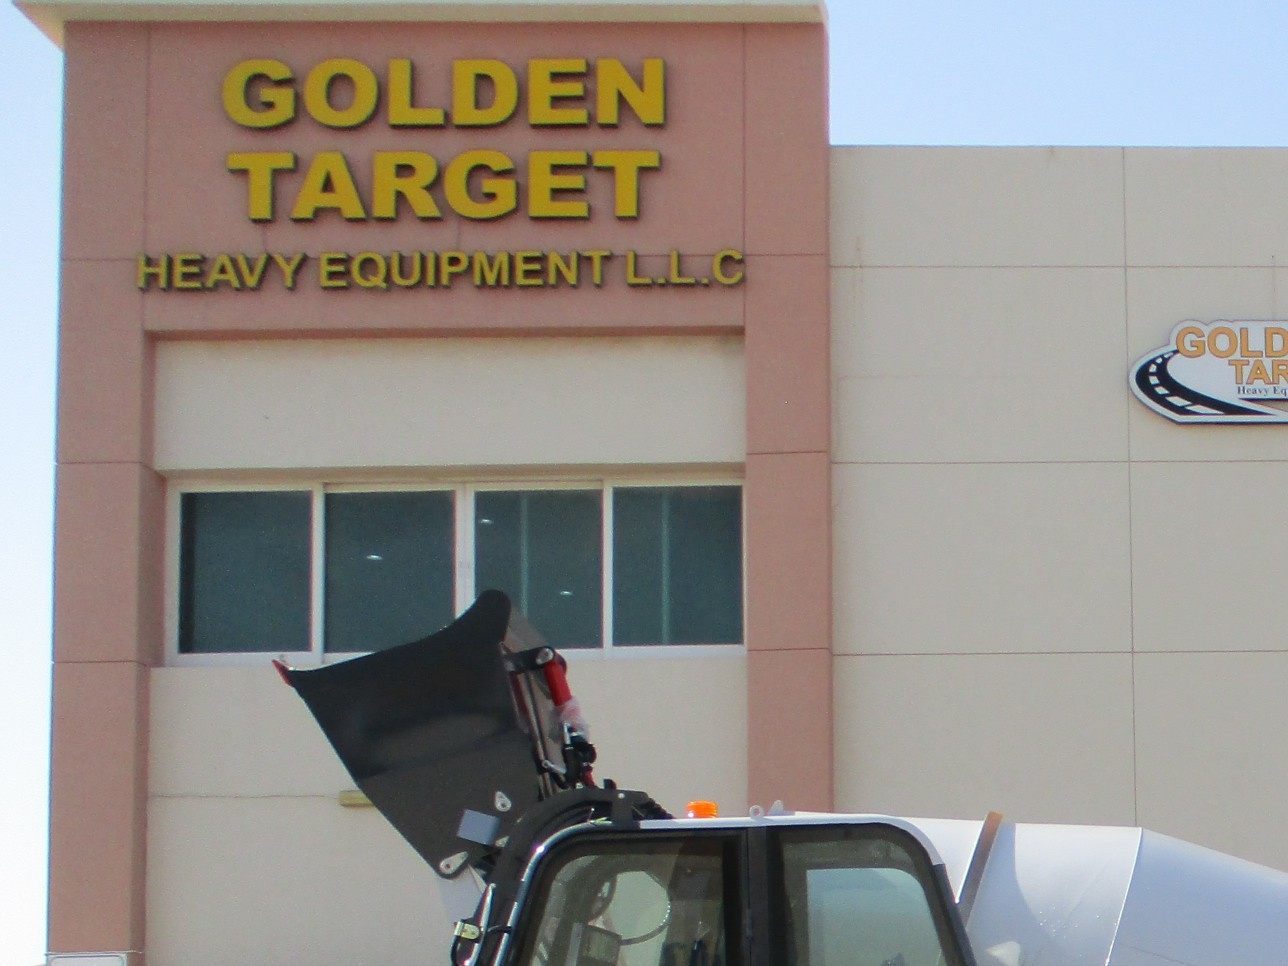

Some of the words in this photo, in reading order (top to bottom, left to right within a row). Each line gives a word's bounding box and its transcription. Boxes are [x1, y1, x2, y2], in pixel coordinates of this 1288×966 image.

[221, 57, 668, 128] GOLDEN
[226, 149, 661, 221] TARGET
[137, 252, 304, 290] HEAVY
[319, 249, 611, 290] EQUIPMENT
[625, 248, 746, 286] L.L.C
[1237, 386, 1270, 397] Heavy
